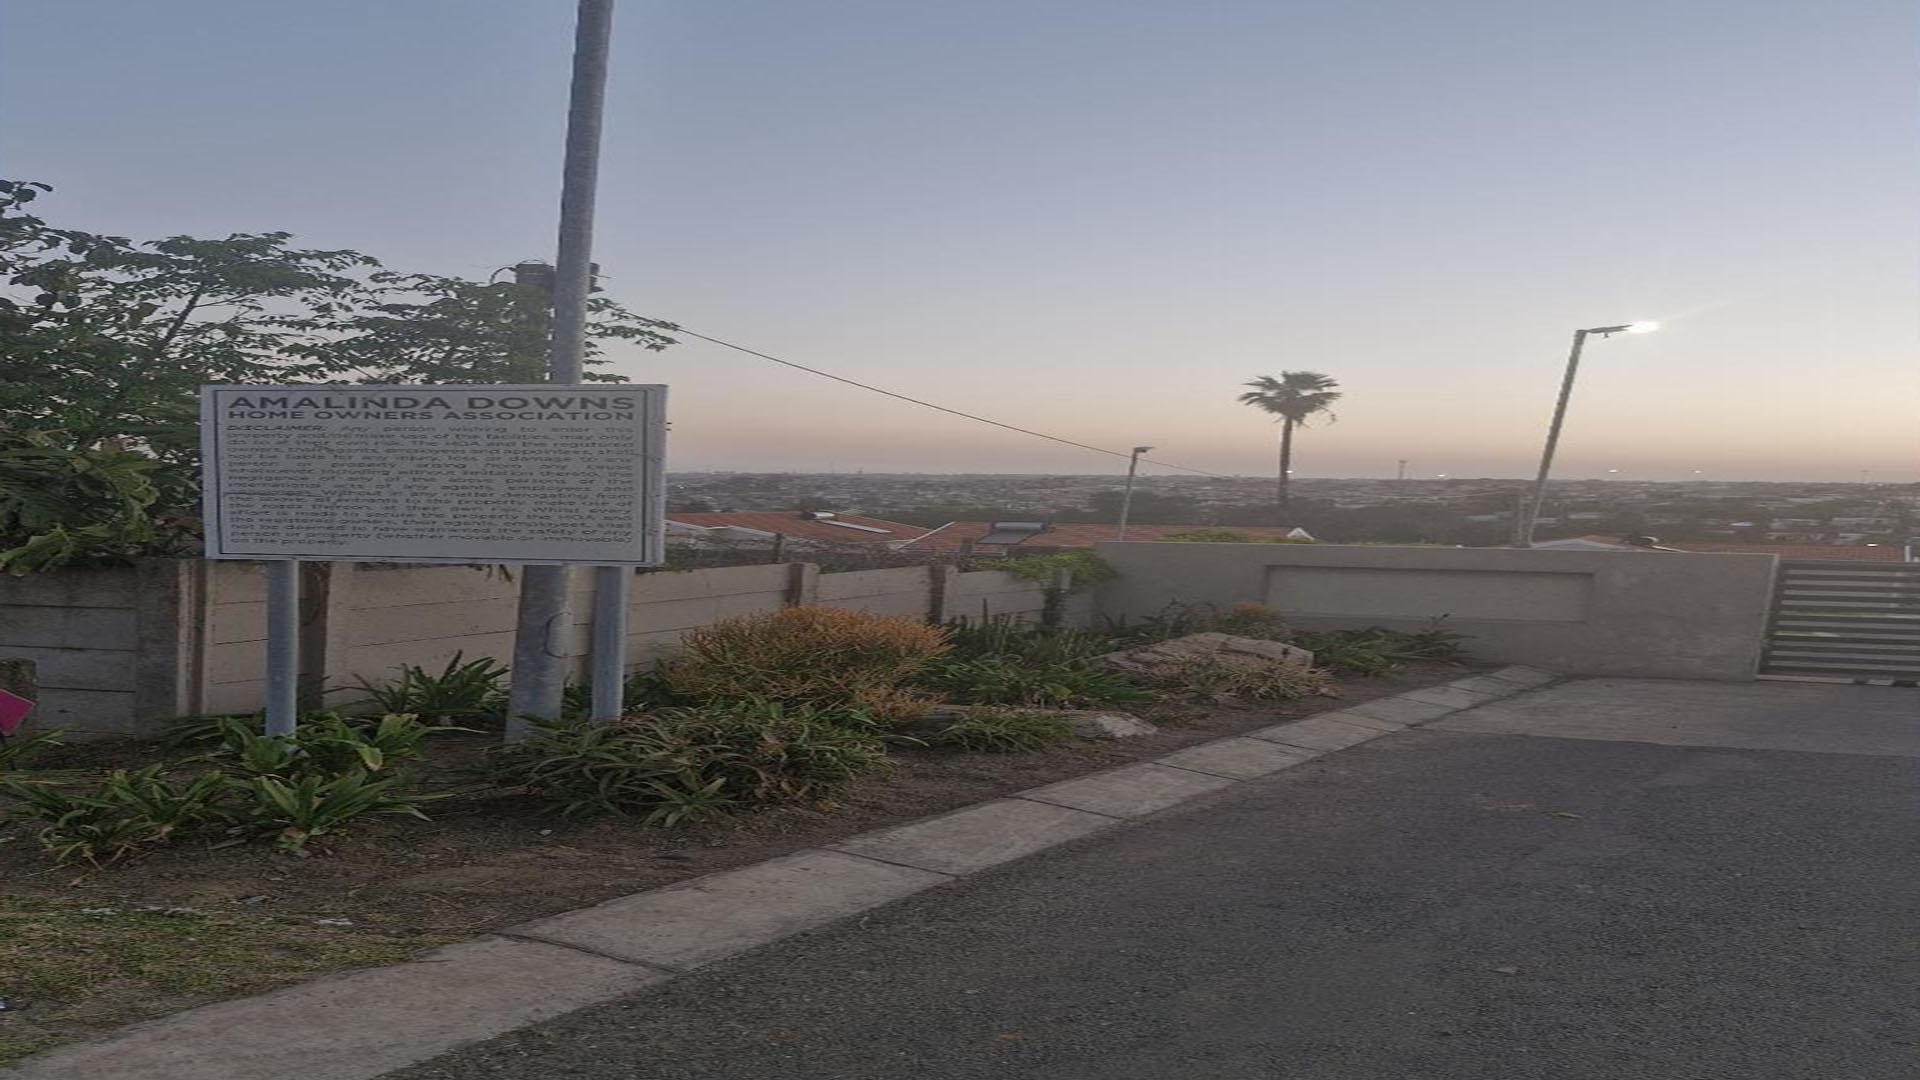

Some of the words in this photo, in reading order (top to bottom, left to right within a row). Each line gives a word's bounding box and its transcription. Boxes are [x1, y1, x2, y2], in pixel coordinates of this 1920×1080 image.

[228, 397, 451, 409] AMALINDA
[467, 397, 635, 410] DOWNS
[228, 411, 305, 420] HOME
[314, 411, 433, 420] OWNERS
[443, 411, 634, 421] ASSOCIATION
